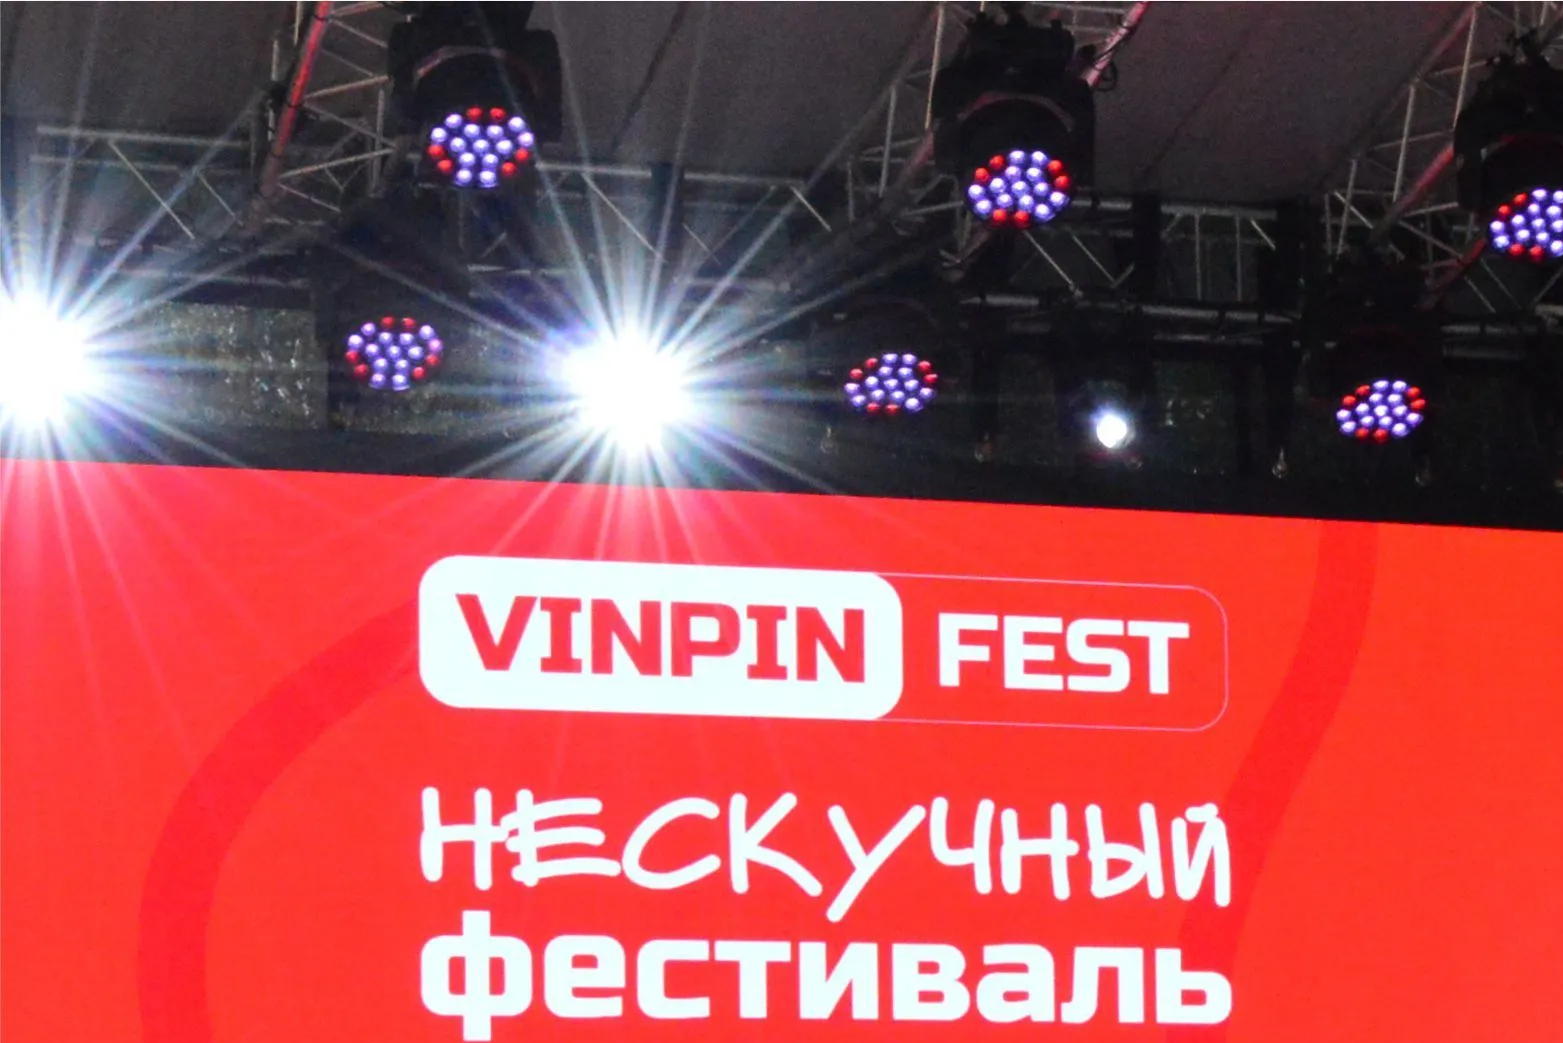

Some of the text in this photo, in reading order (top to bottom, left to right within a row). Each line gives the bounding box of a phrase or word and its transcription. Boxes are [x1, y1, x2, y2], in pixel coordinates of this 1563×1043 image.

[456, 594, 1190, 694] VINPIN FEST
[420, 787, 1232, 922] НЕСКУЧНЫЙ
[420, 910, 1234, 1042] фестиваль
